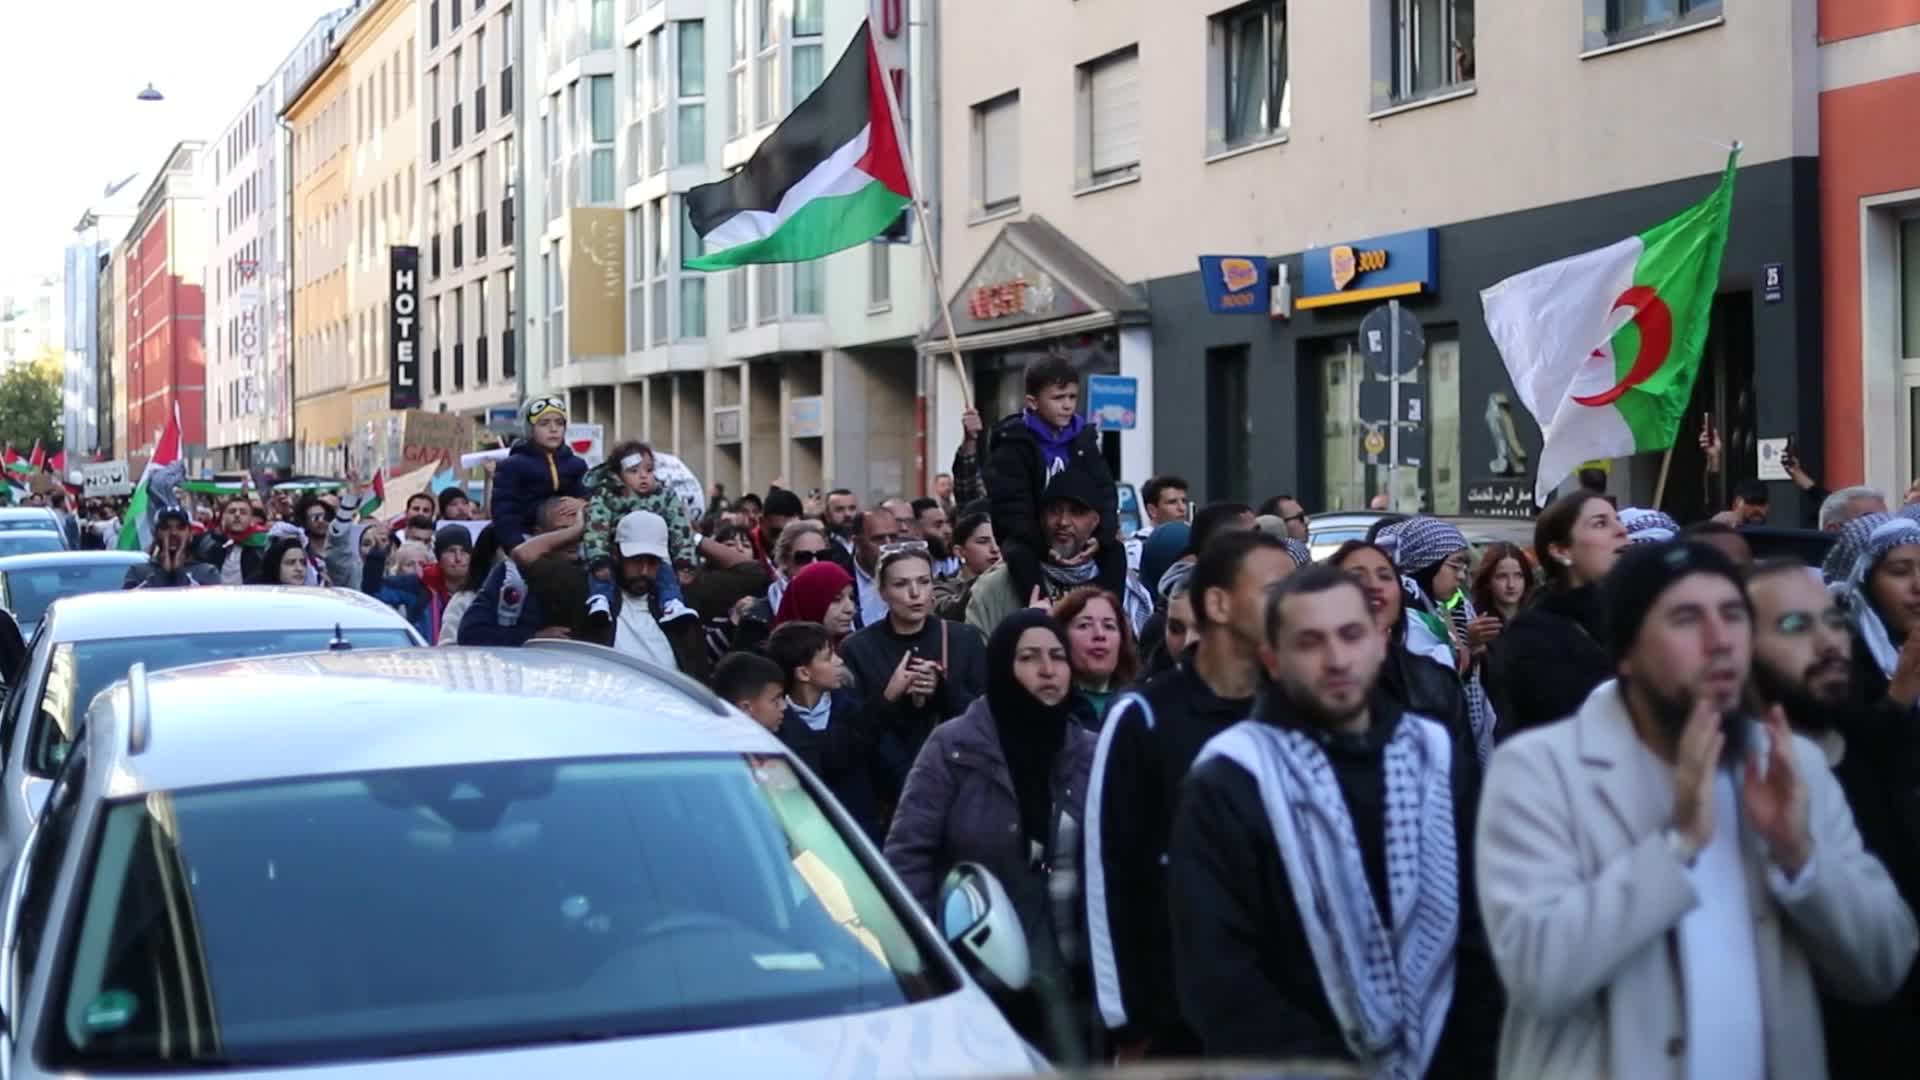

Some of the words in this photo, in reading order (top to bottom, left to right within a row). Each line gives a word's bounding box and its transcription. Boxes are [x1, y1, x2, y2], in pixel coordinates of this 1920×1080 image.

[1767, 267, 1779, 286] 25
[395, 269, 415, 386] HOTEL
[241, 310, 258, 414] HOTEL
[86, 473, 122, 487] NOW
